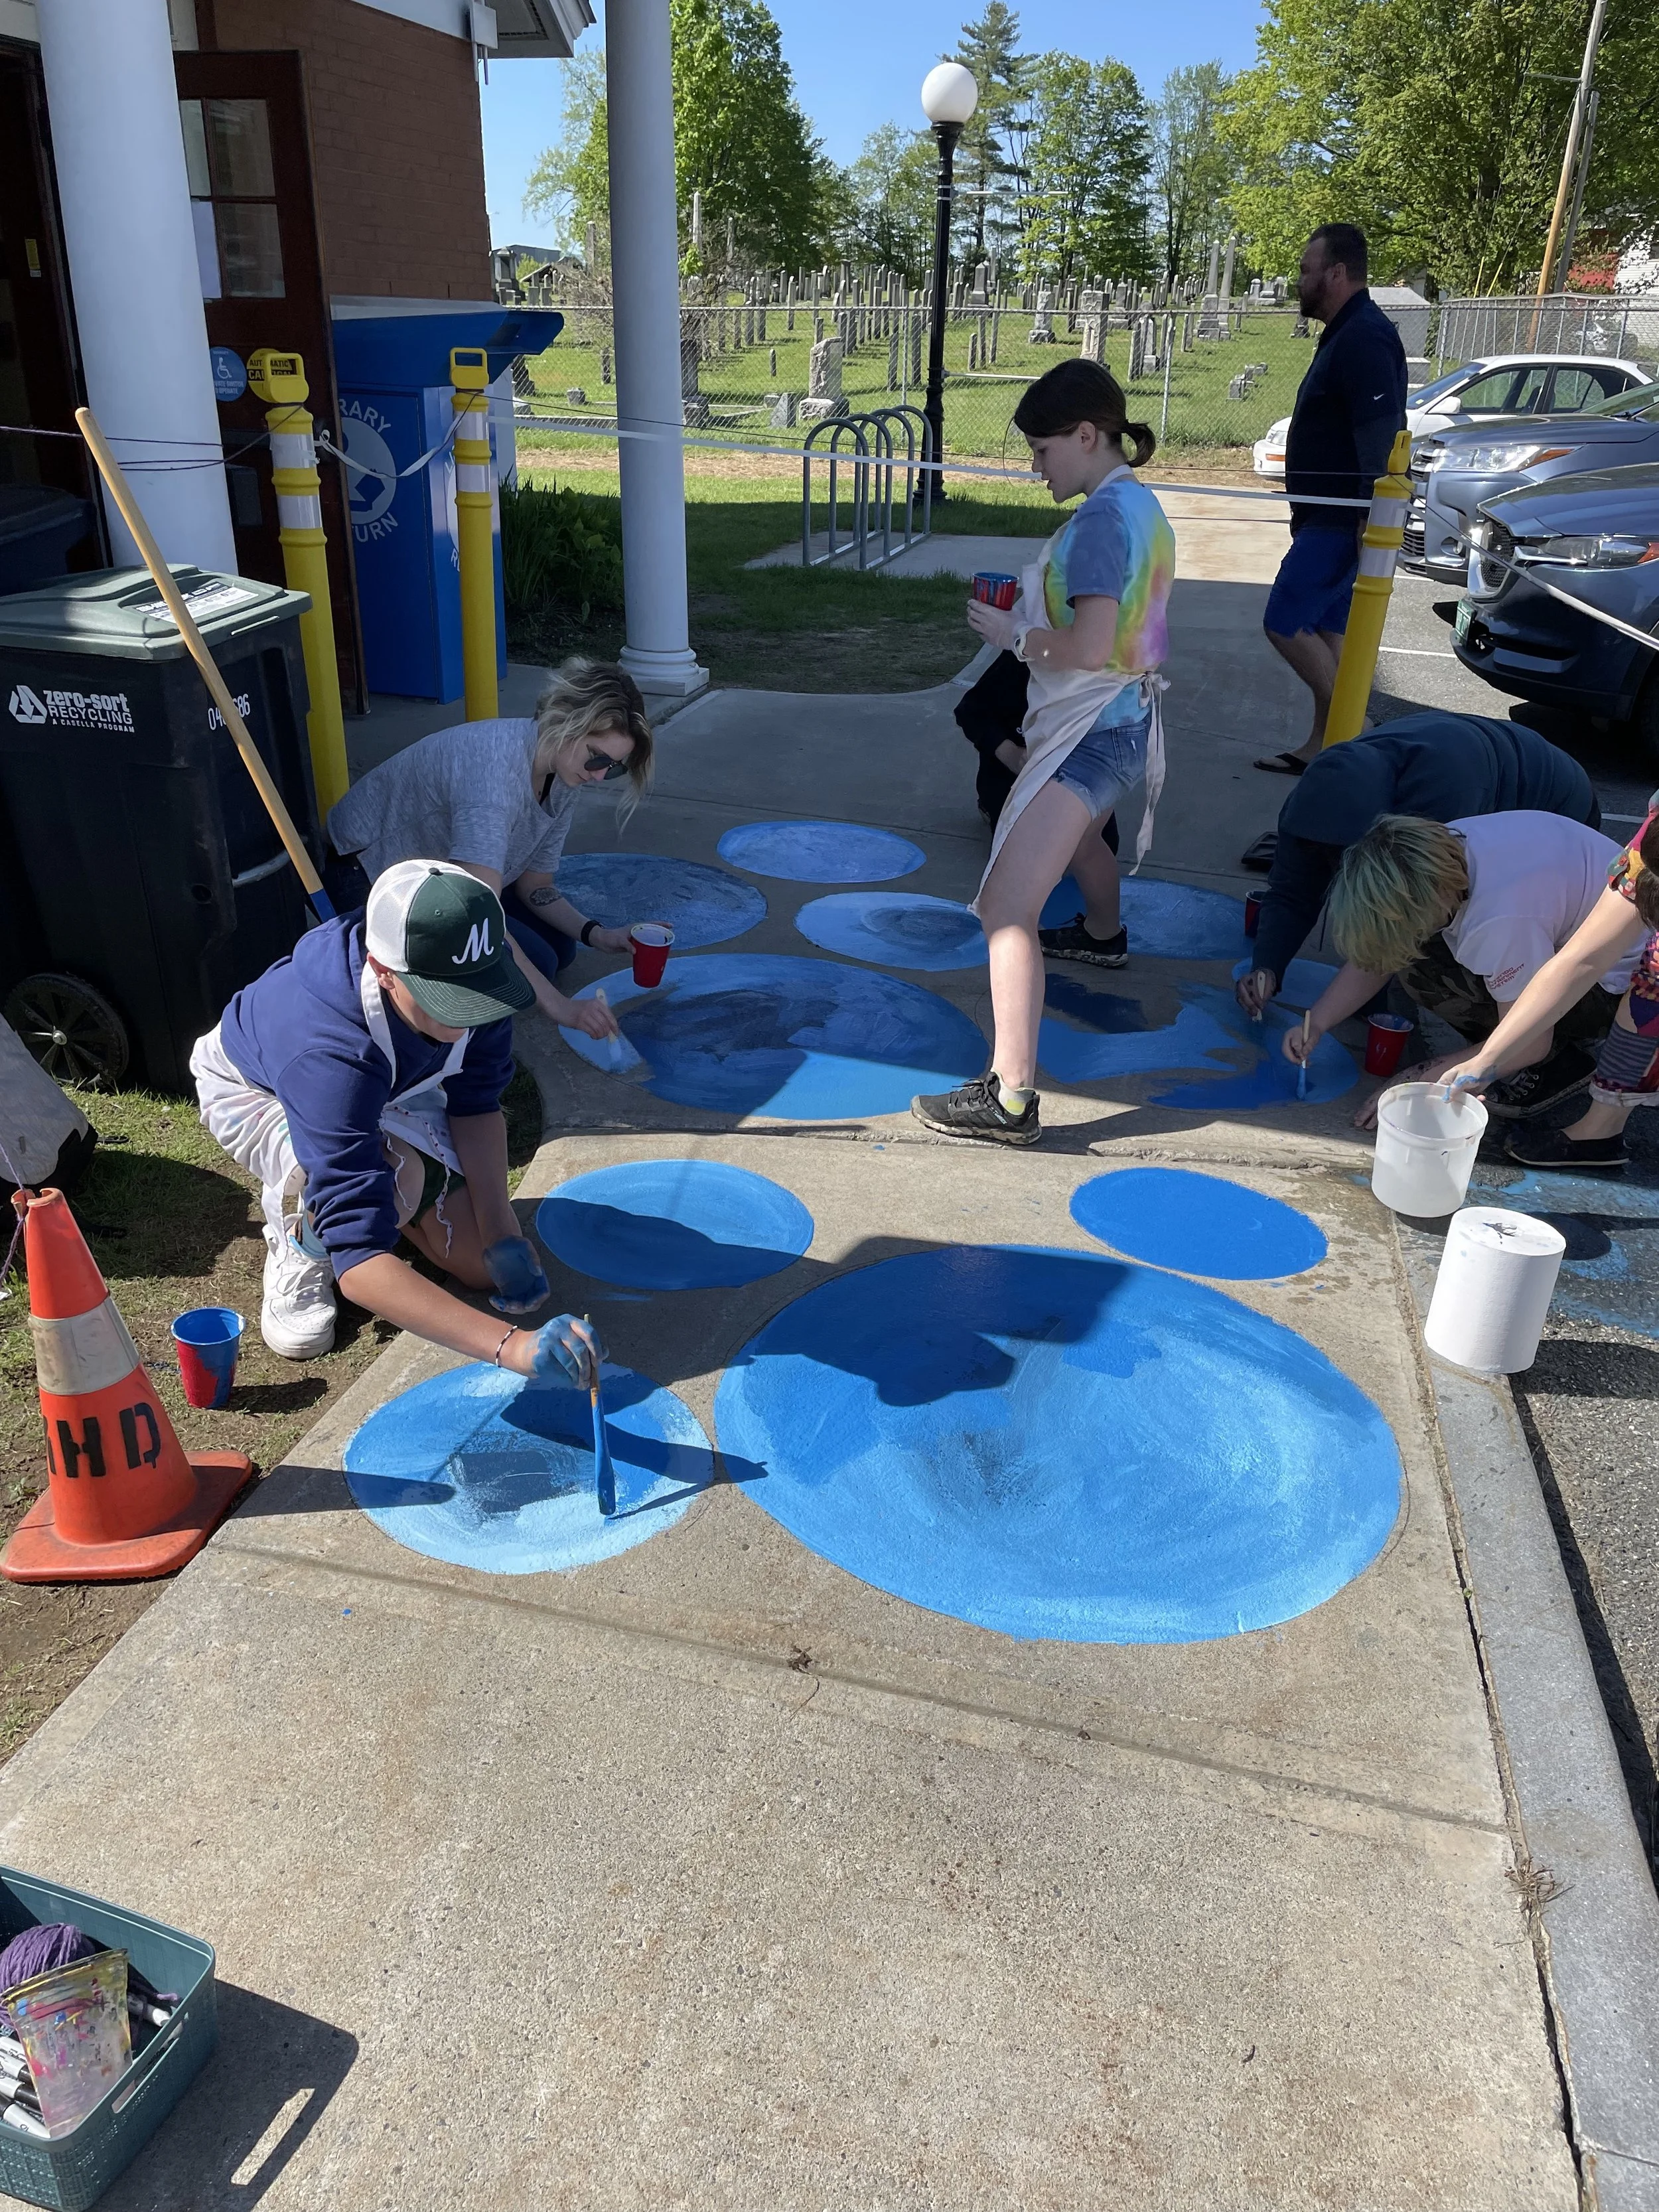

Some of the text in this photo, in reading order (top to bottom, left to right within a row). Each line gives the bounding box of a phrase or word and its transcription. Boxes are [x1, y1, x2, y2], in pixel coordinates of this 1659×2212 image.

[338, 398, 392, 433] RARY
[43, 690, 130, 712] zero-sort
[48, 705, 133, 725] RECYCLING
[60, 719, 96, 729] CASELLA
[98, 722, 135, 733] PROGRAM
[451, 917, 494, 964] M
